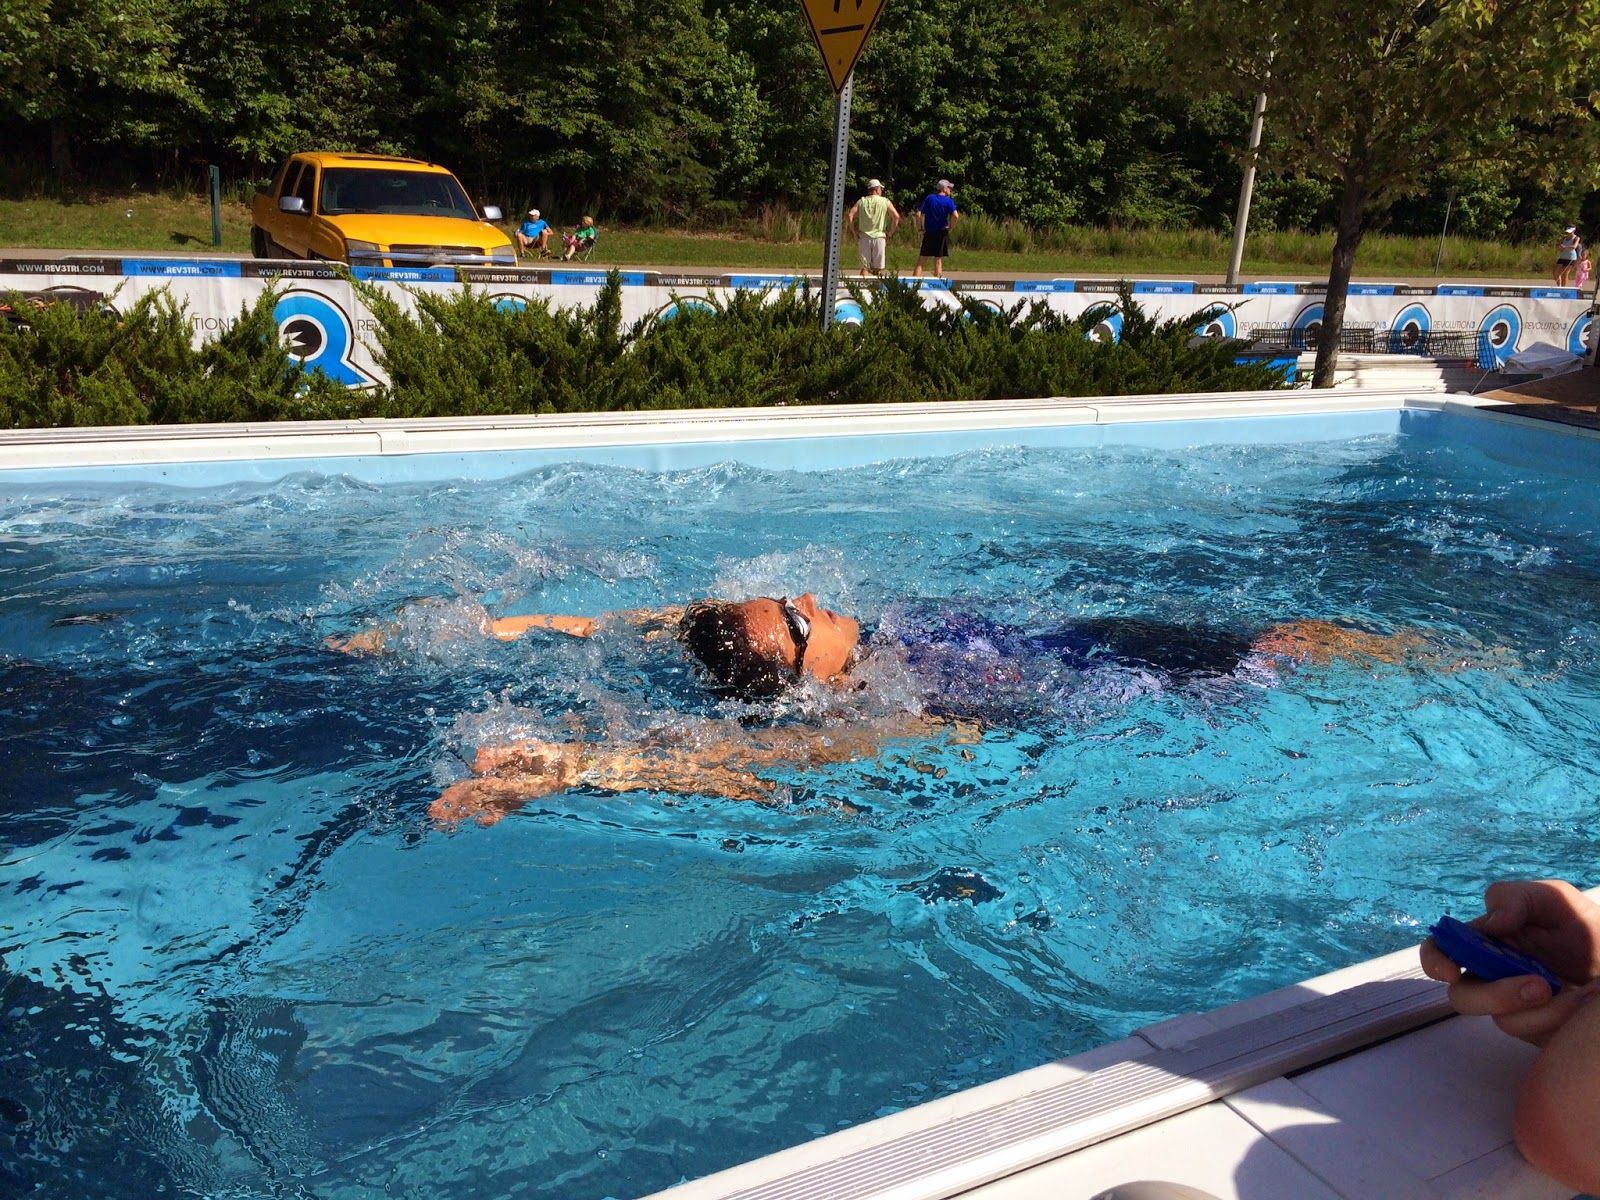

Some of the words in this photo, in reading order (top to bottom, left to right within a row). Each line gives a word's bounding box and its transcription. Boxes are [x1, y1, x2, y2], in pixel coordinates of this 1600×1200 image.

[16, 263, 105, 273] WWW.REV3TRI.COM
[140, 265, 224, 274] WWW.REV3TRI.COM
[258, 267, 337, 278] WWW.REV3TRI.COM
[469, 273, 538, 283] WWW.REV3TRI.COM
[658, 278, 721, 286] WWW.REV3TRI.COM
[1433, 320, 1476, 329] REVOLUTION3
